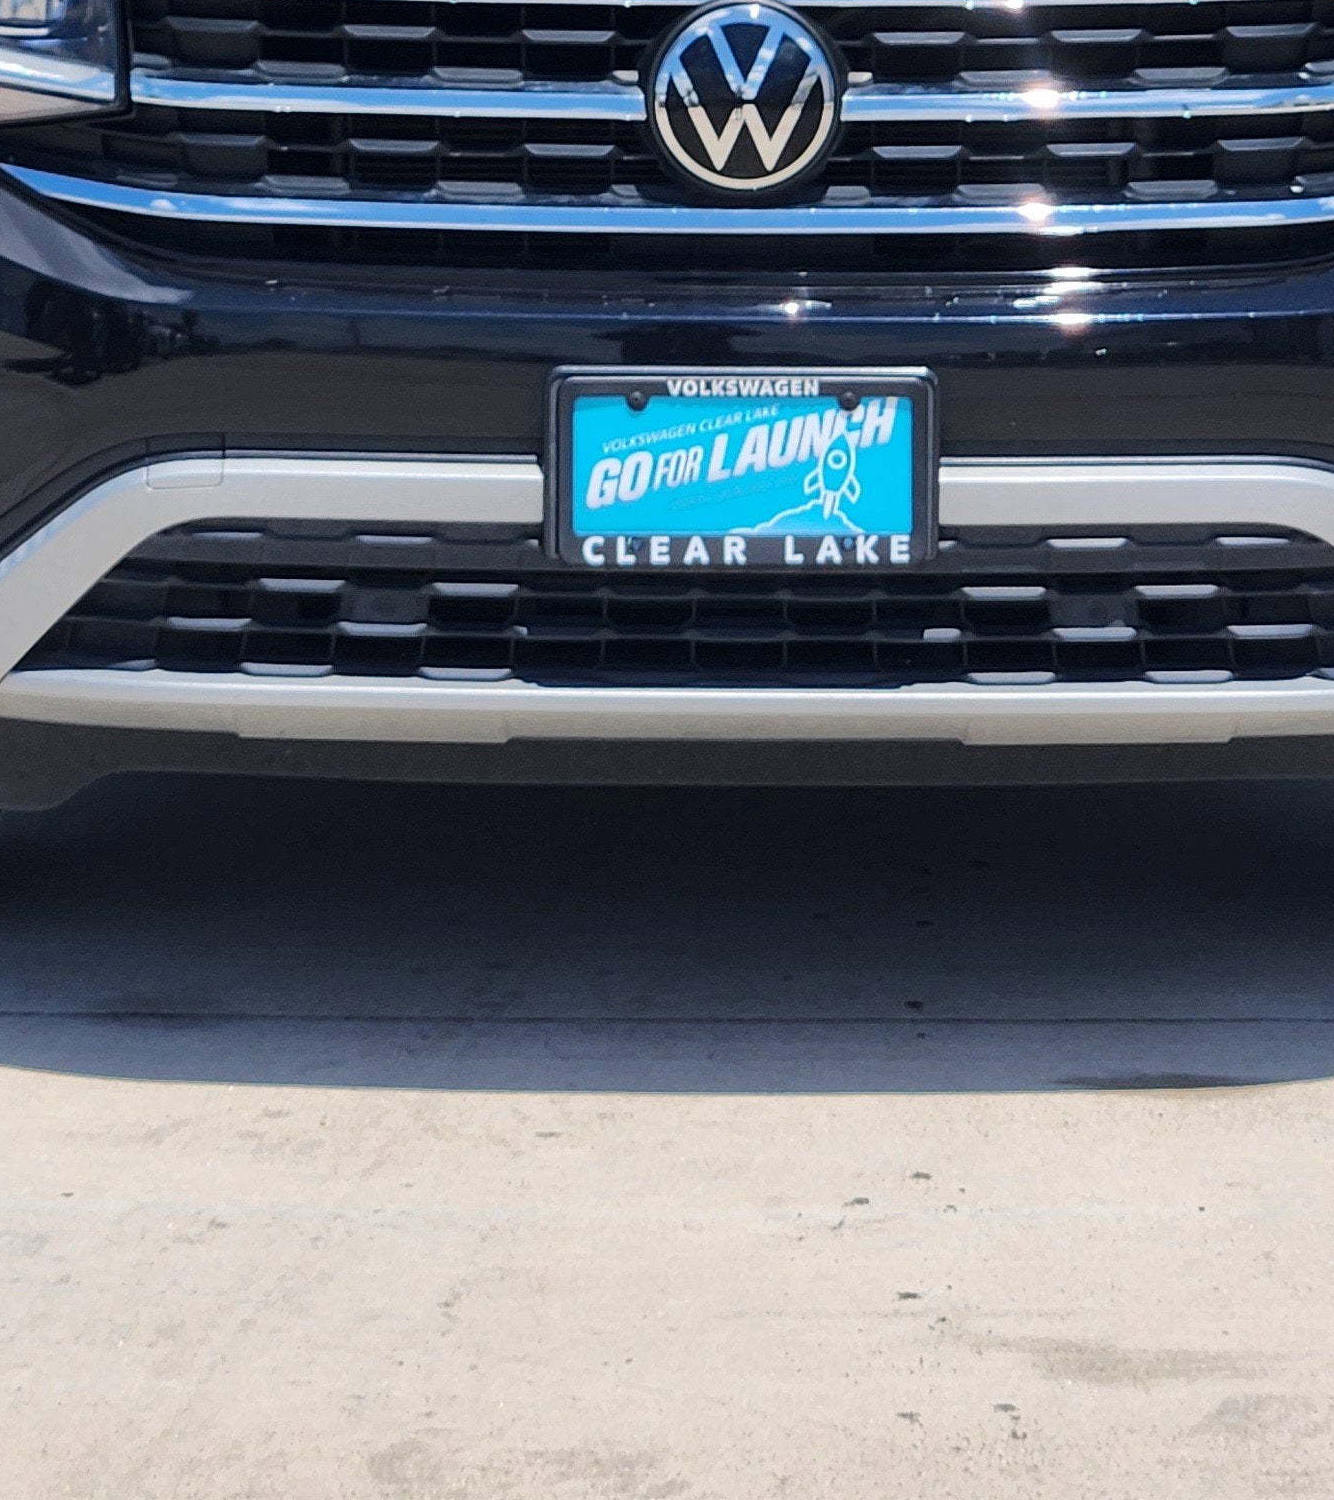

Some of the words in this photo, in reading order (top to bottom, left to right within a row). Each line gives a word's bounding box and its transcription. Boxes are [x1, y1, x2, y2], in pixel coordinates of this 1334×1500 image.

[667, 378, 819, 398] VOLKSWAGEN
[602, 421, 697, 454] VOLKSWAGEN
[698, 411, 743, 432] CLEAR
[745, 403, 780, 423] LAKE
[585, 450, 654, 510] GO
[654, 444, 704, 492] FOR
[707, 396, 899, 483] LAUNCH
[582, 534, 748, 567] CLEAR
[783, 534, 911, 566] LAKE
